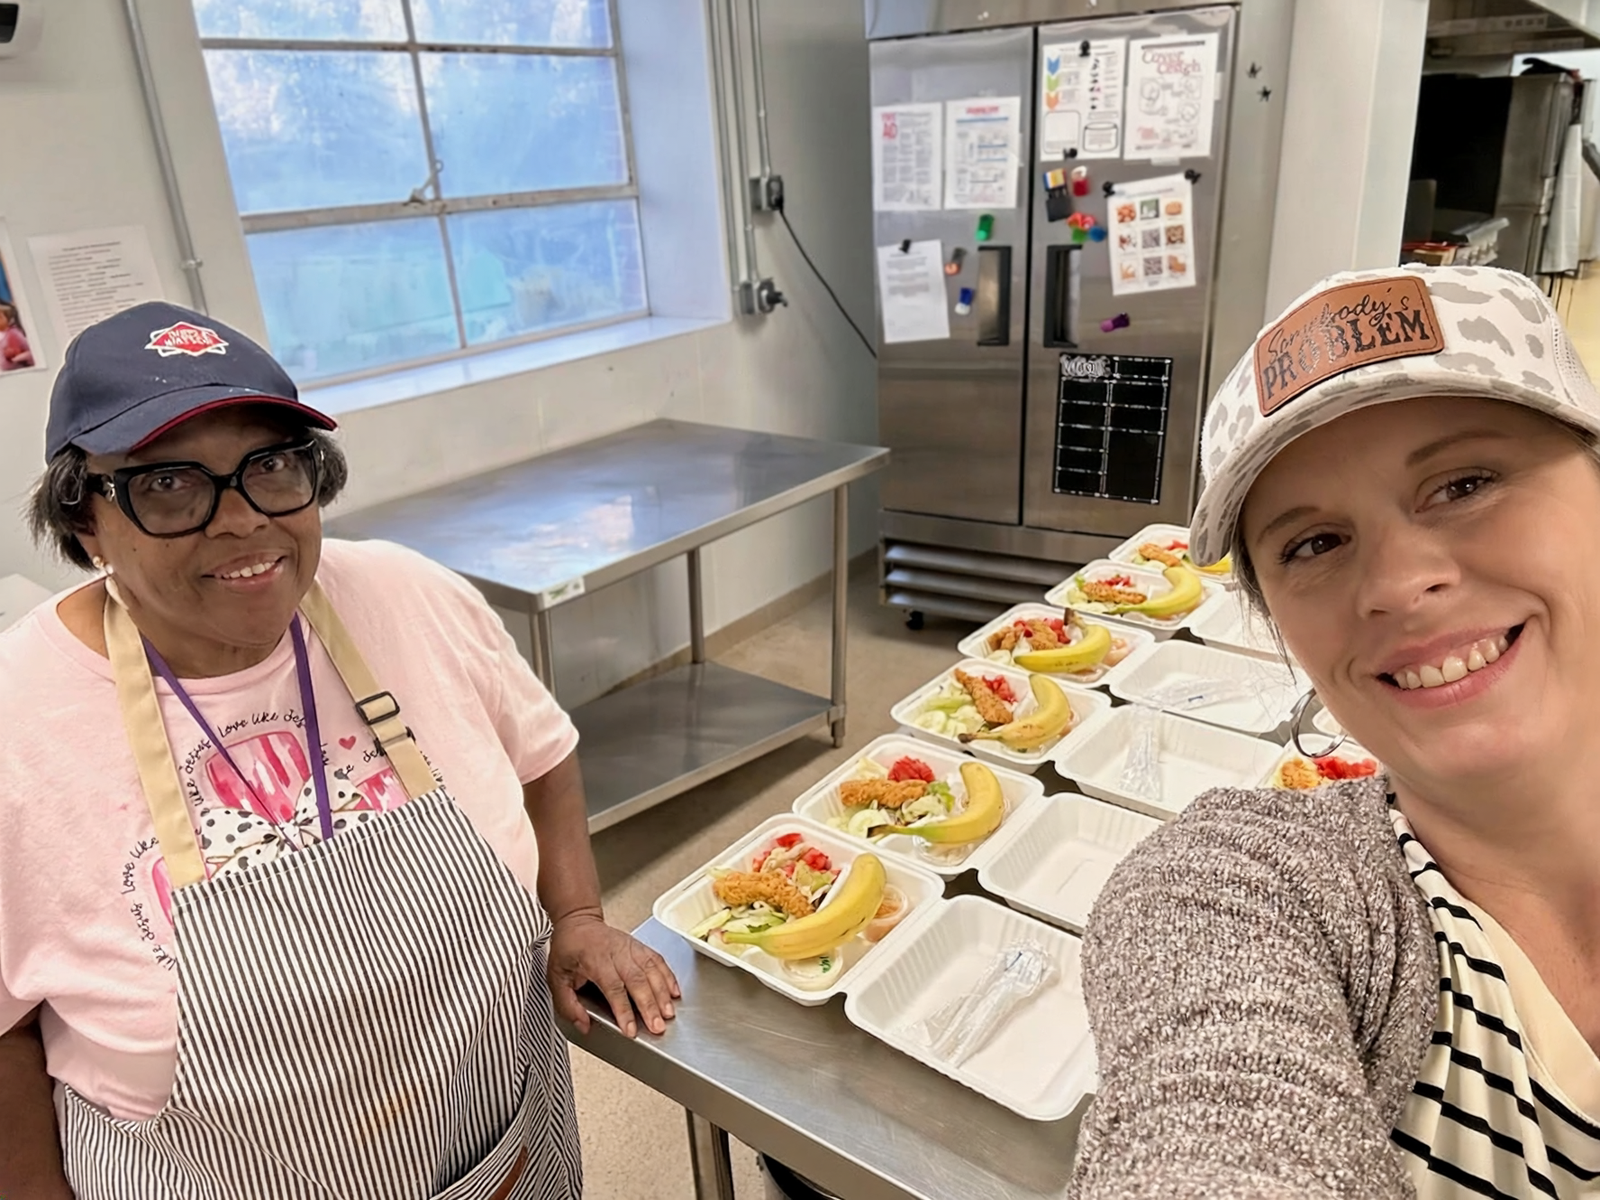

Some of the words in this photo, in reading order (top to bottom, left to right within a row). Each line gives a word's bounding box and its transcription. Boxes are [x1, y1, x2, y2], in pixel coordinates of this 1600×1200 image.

[1262, 308, 1431, 400] PROBLEM
[217, 719, 248, 738] Love
[251, 712, 279, 725] like
[283, 709, 306, 728] Jes
[120, 862, 136, 895] Love
